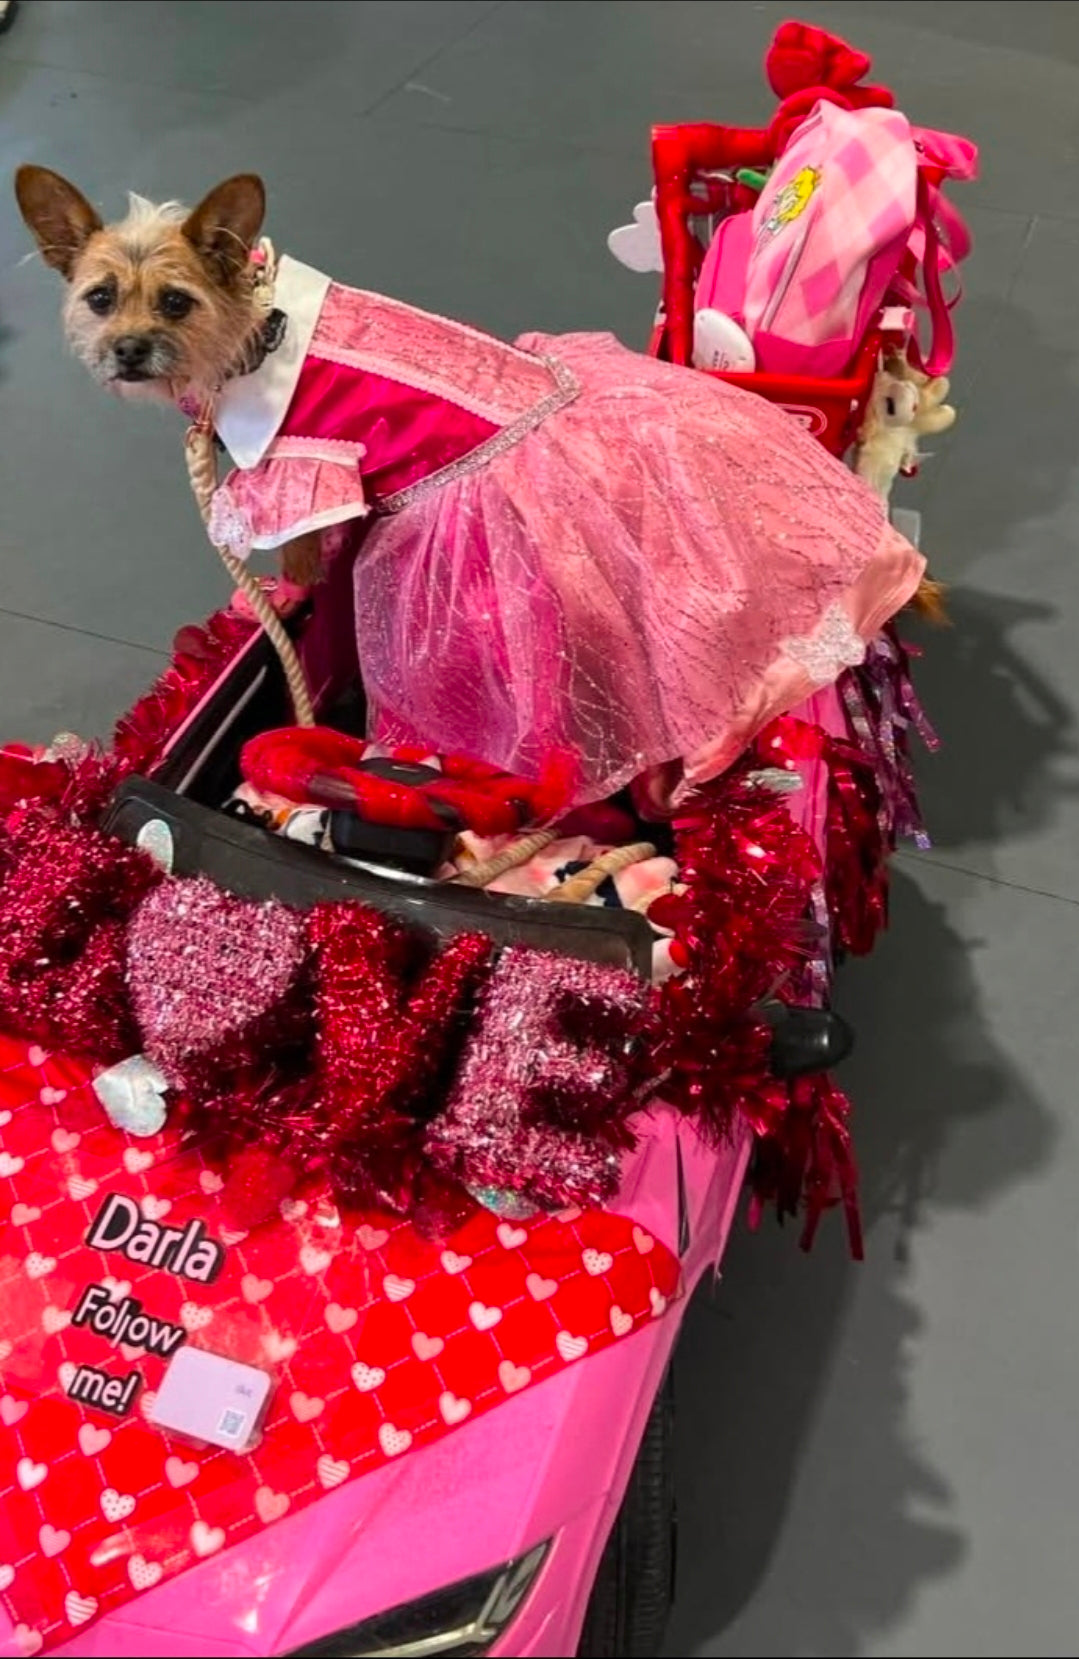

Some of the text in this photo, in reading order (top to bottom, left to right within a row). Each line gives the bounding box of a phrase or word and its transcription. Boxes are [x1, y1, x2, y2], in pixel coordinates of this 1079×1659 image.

[90, 1194, 219, 1282] Darla
[75, 1288, 184, 1352] Follow
[70, 1368, 138, 1412] me!
